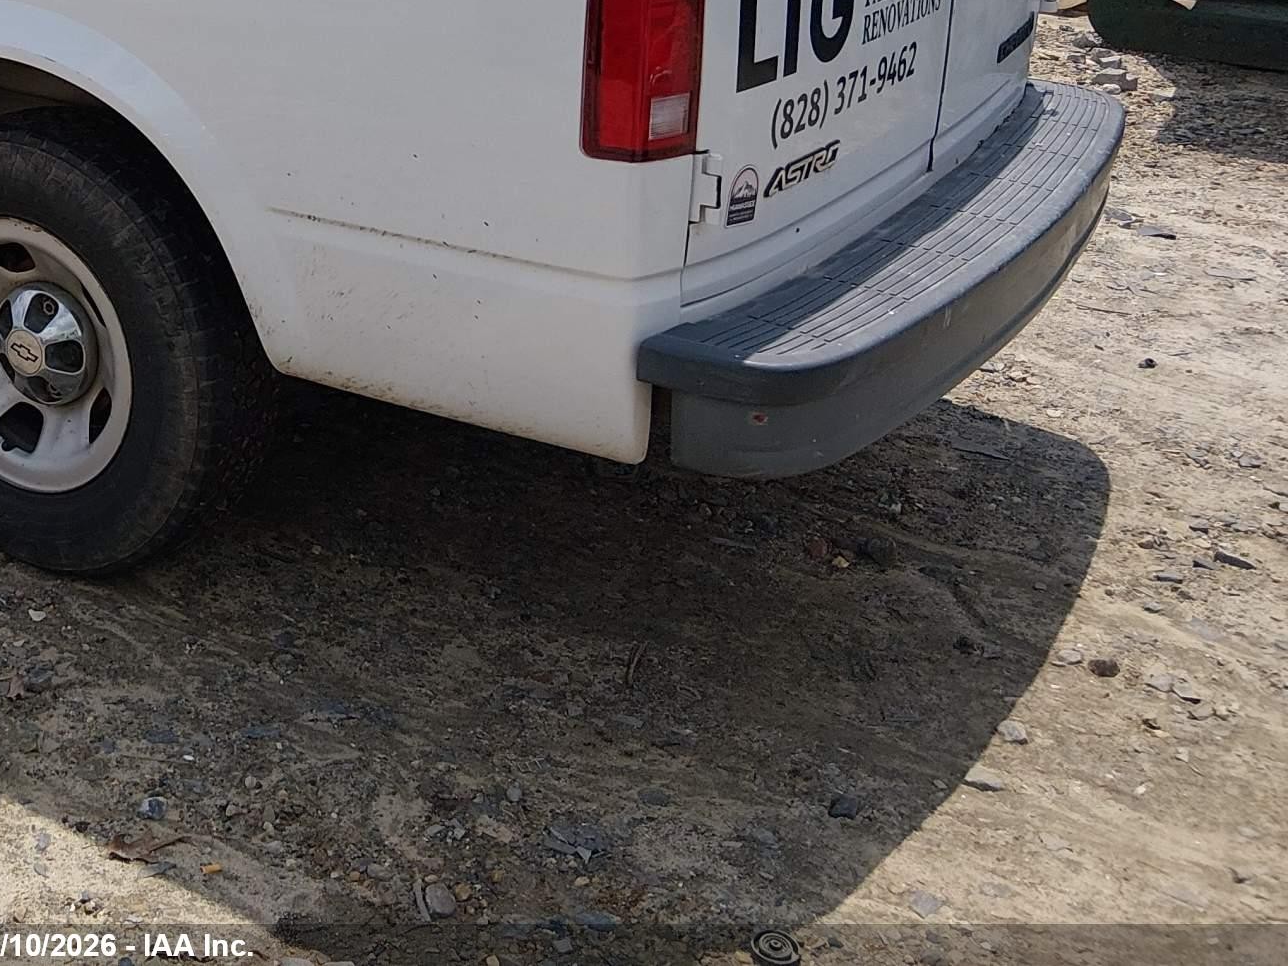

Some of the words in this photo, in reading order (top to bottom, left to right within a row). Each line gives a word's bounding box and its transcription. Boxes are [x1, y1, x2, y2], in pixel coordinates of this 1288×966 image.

[771, 79, 829, 150] (828)
[834, 41, 918, 115] 371-9462
[763, 139, 841, 198] ASTRO
